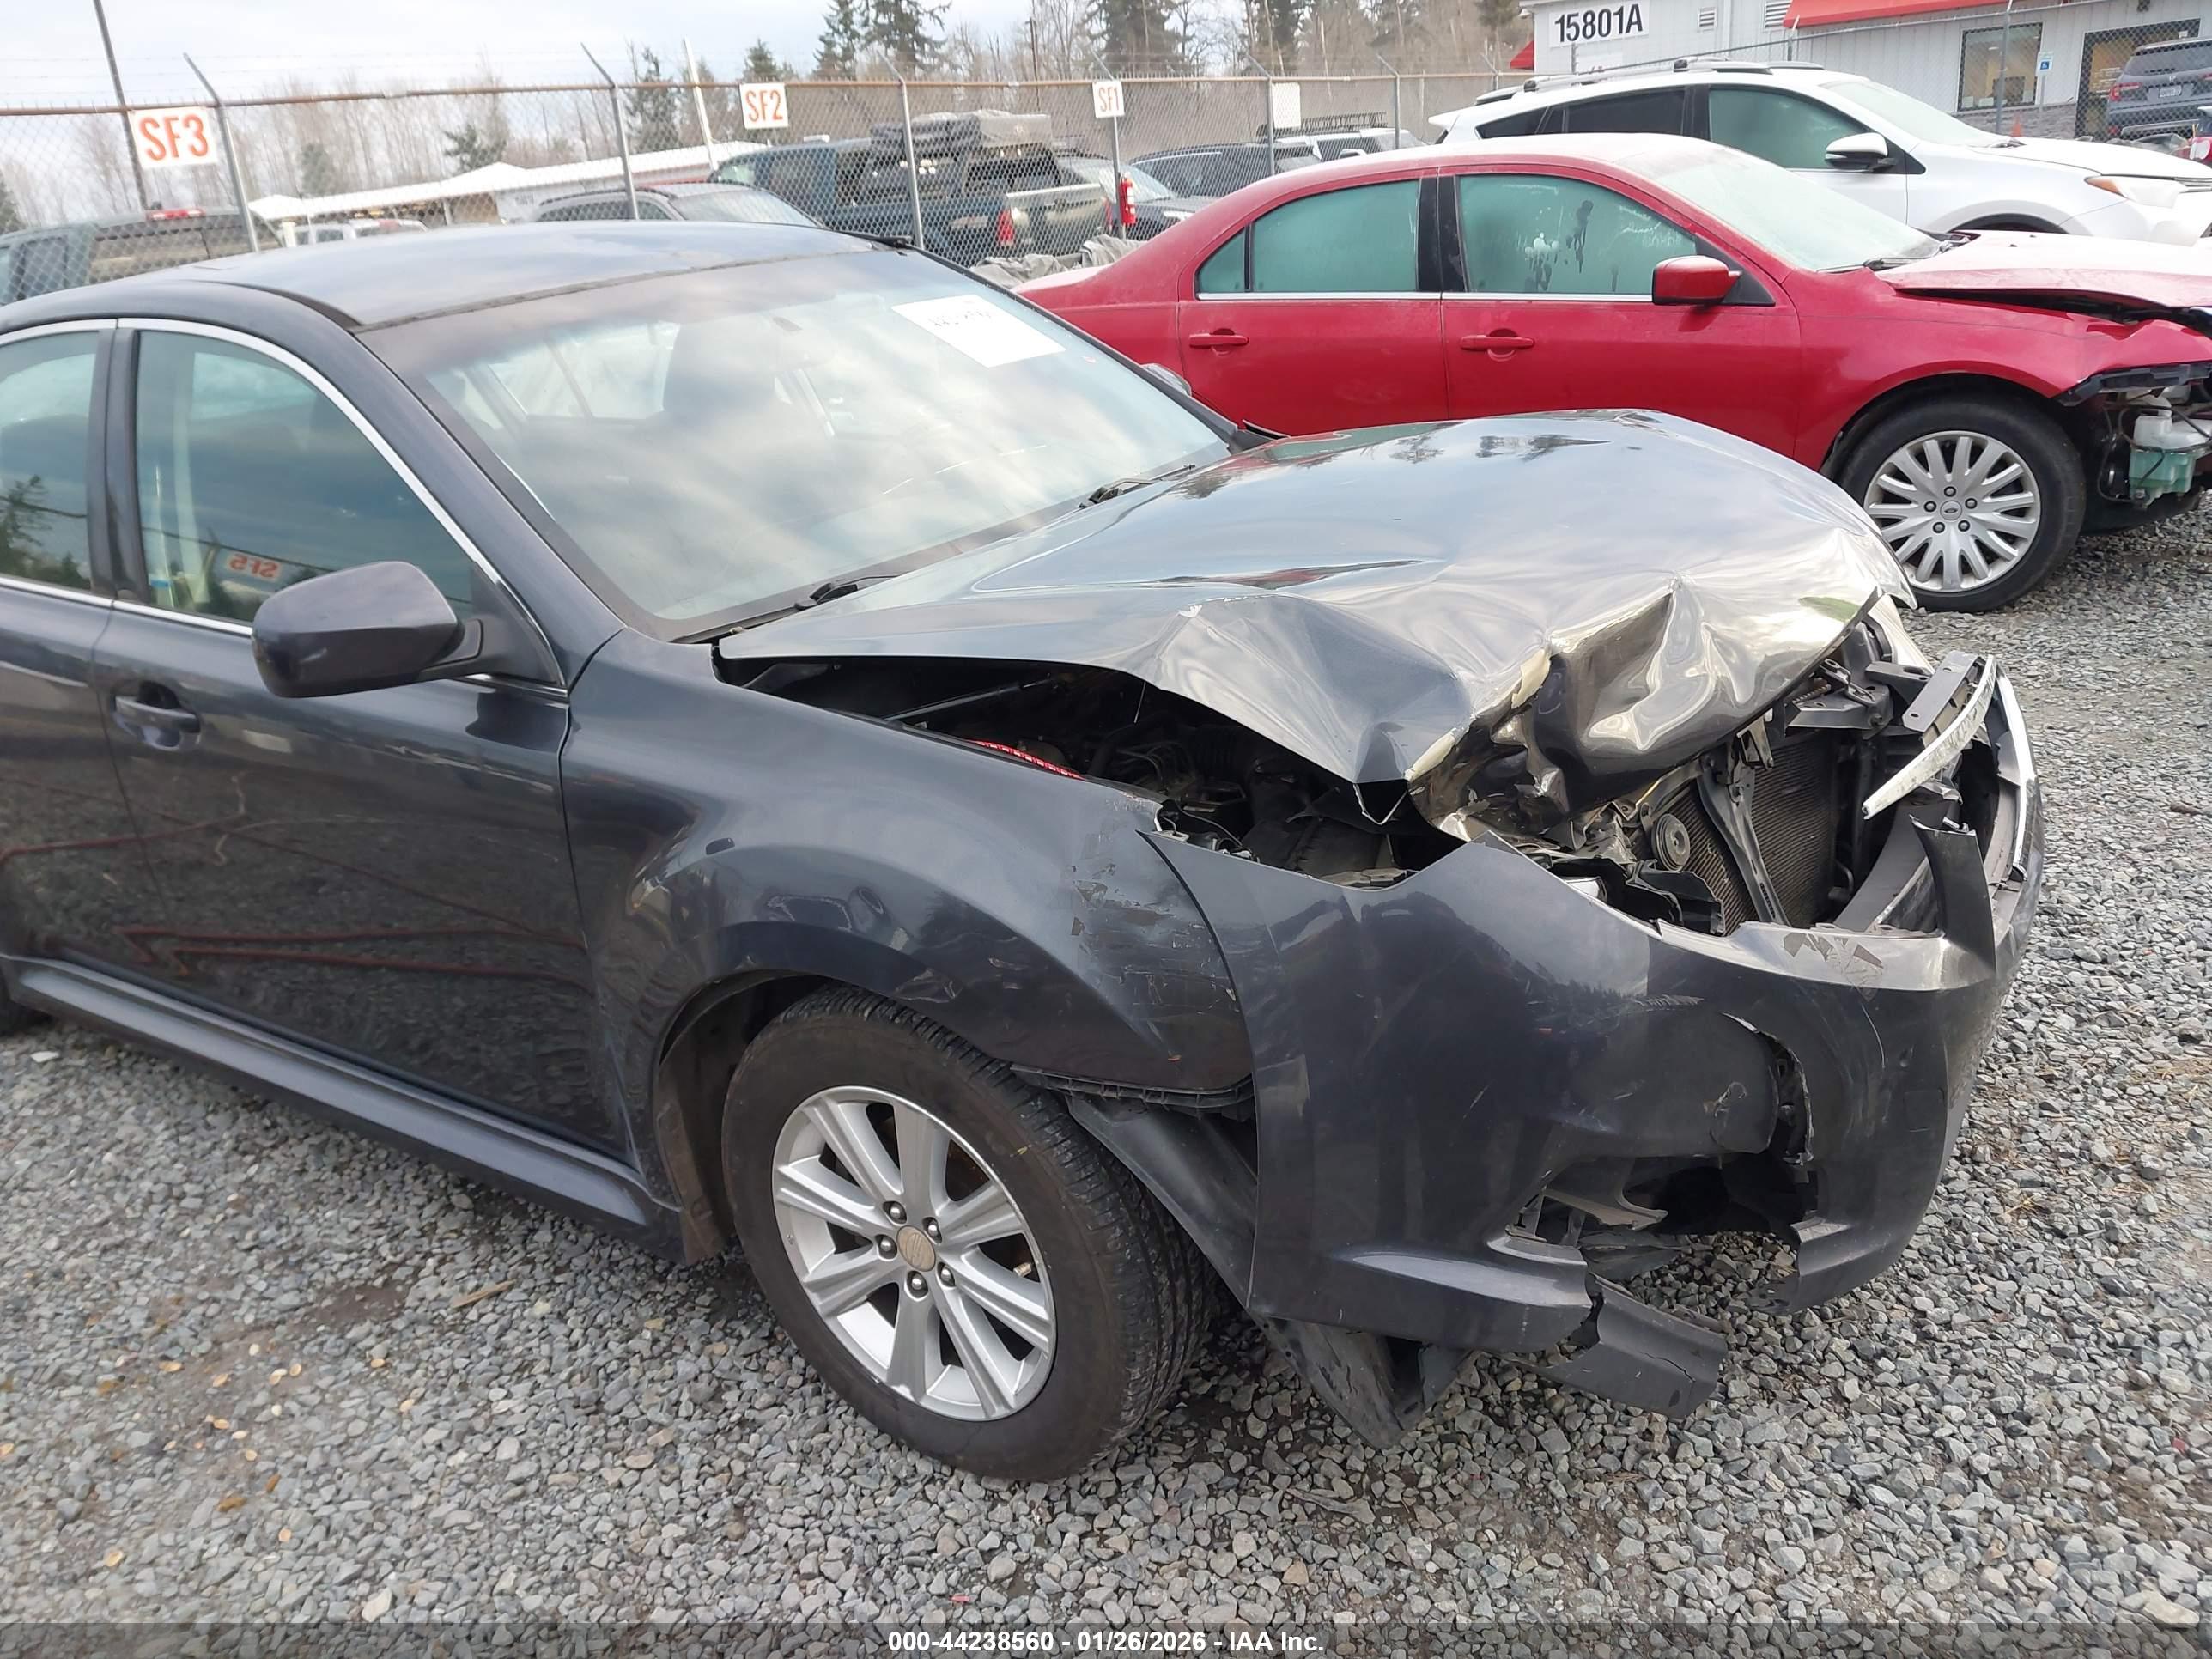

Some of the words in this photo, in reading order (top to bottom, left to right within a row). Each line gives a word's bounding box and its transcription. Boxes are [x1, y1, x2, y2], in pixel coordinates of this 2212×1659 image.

[1554, 3, 1644, 43] 15801A
[745, 89, 783, 122] SF2
[1098, 86, 1120, 112] SF1
[139, 113, 209, 161] SF3
